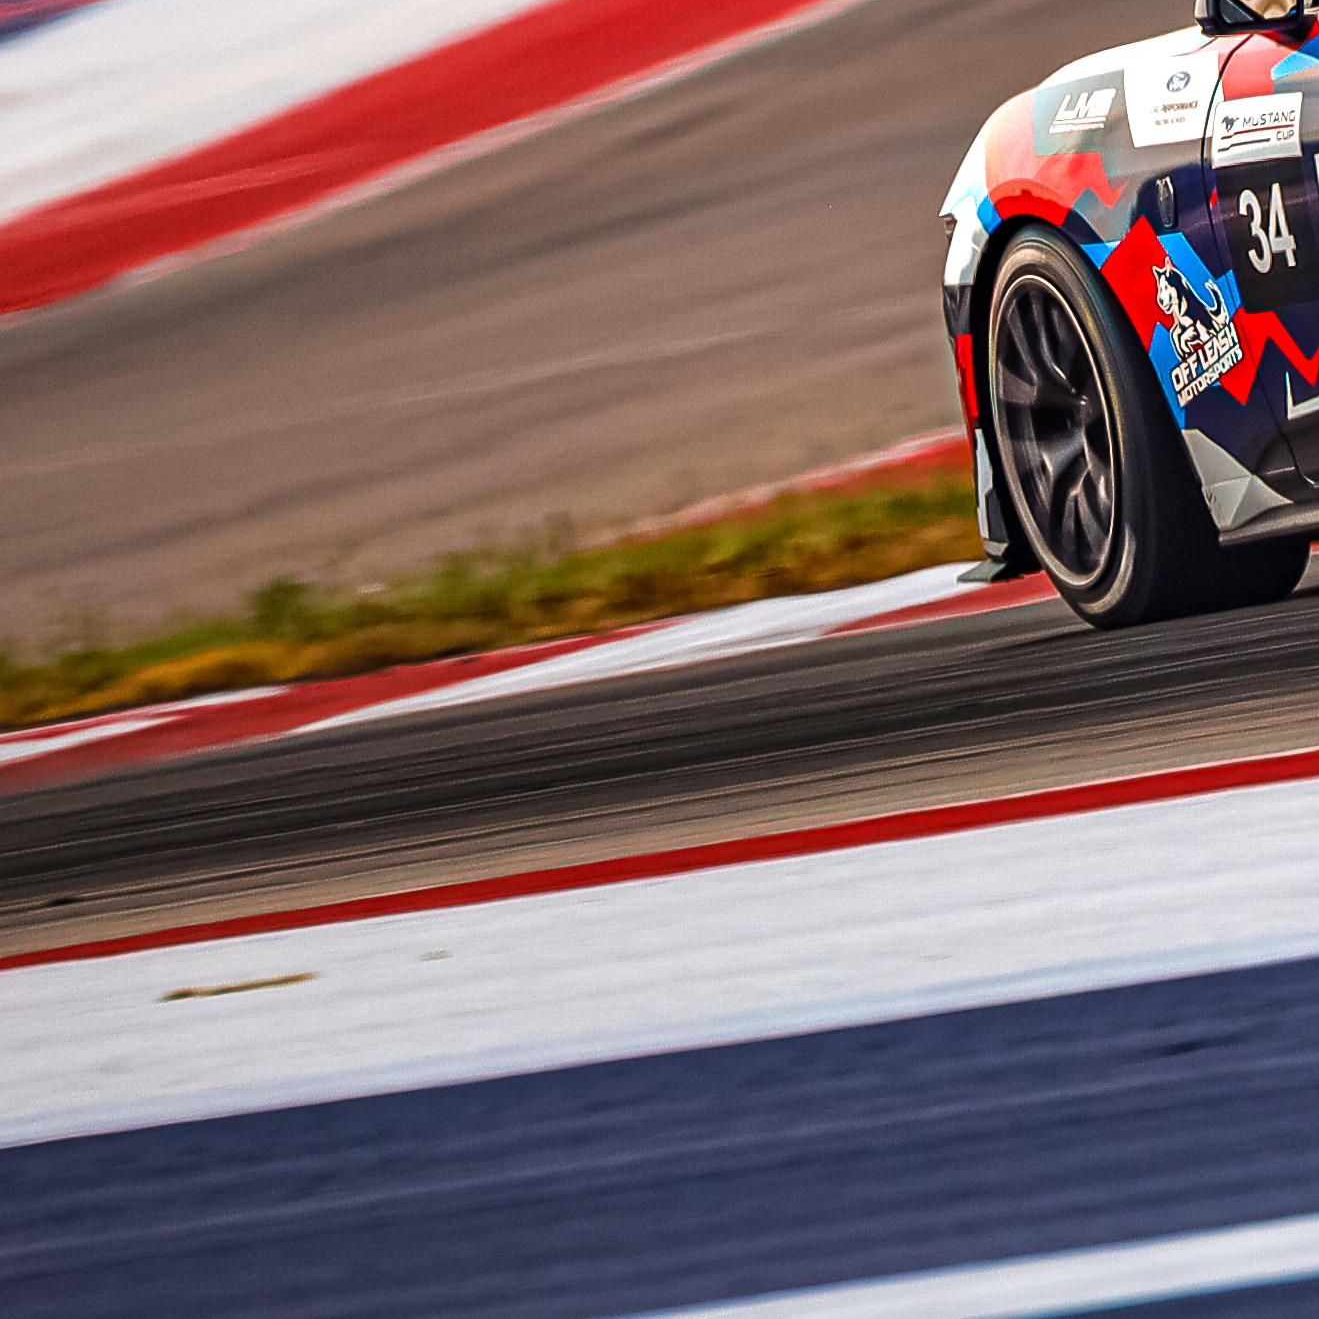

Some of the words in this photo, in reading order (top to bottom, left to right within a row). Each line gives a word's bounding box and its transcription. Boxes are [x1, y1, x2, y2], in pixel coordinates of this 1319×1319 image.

[1242, 110, 1296, 128] MUSTANG
[1276, 129, 1295, 141] CUP
[1239, 183, 1297, 274] 34
[1171, 352, 1198, 392] OFF
[1197, 321, 1239, 371] LEASH
[1177, 343, 1243, 407] MOTORSPORTS
